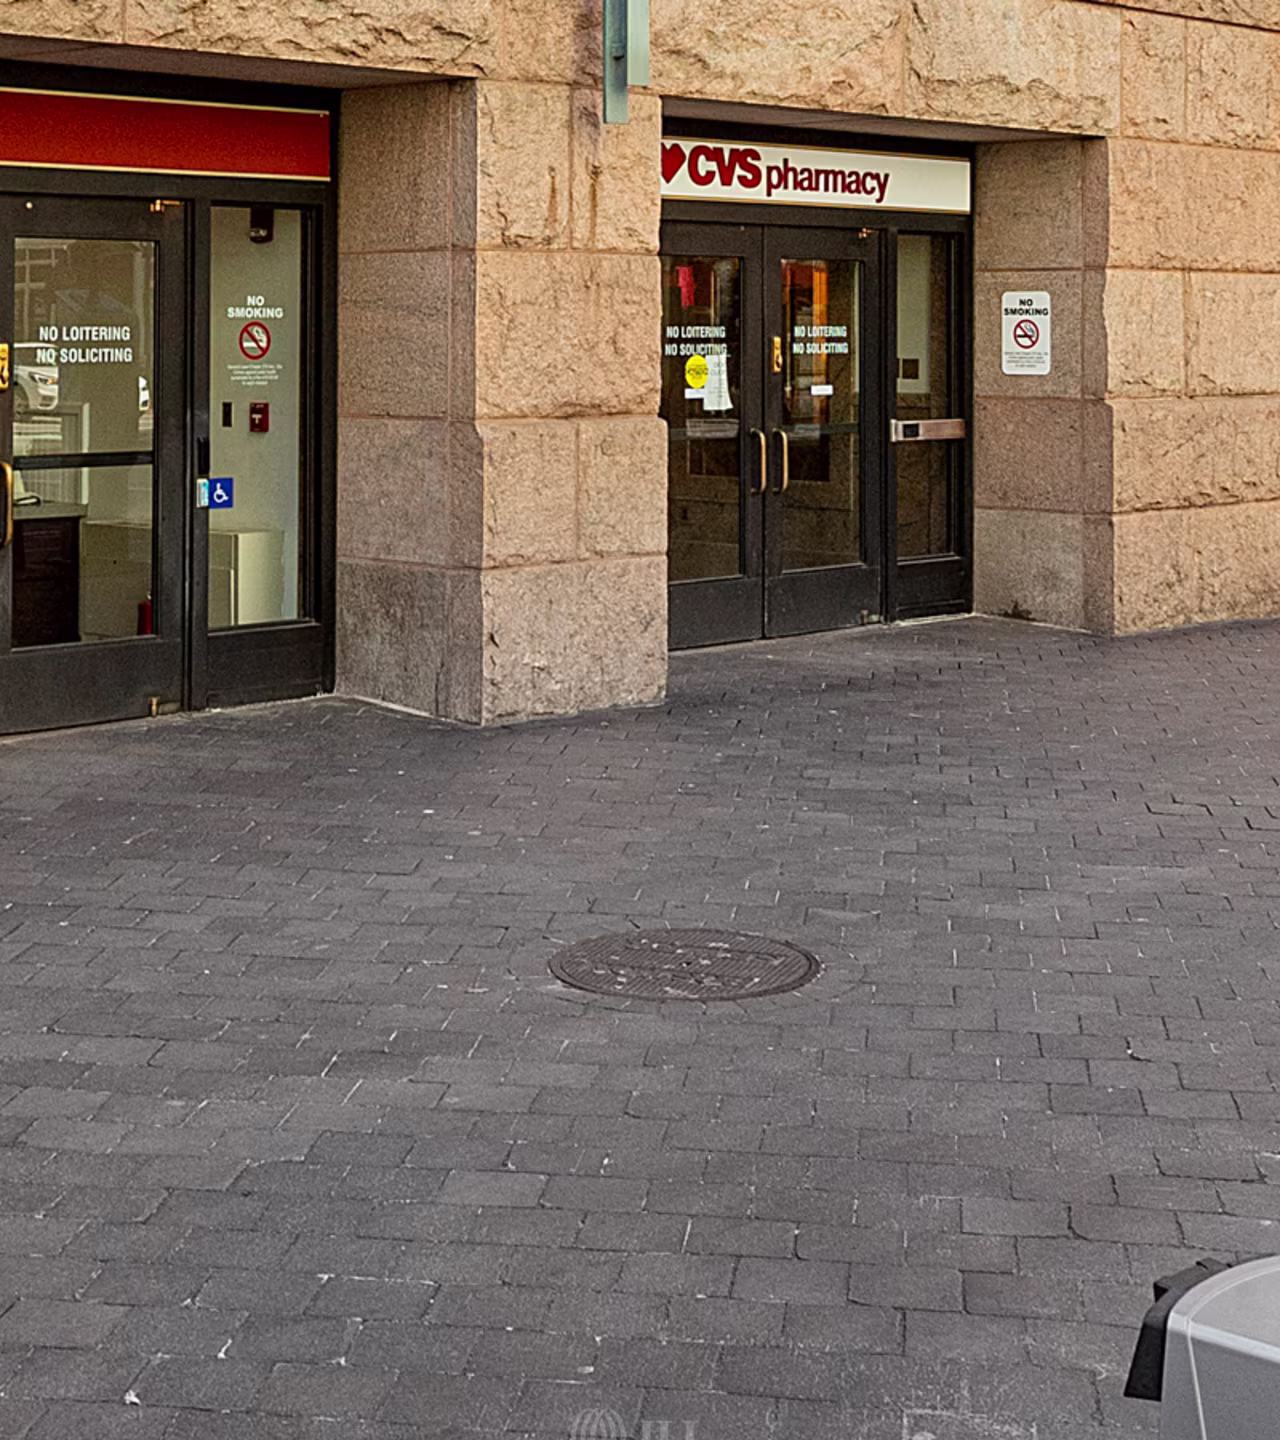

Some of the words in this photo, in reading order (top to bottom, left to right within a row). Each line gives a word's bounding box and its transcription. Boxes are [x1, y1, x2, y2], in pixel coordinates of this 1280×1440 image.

[687, 145, 762, 188] CVS
[766, 158, 890, 203] pharmacy
[247, 295, 265, 307] NO
[1019, 299, 1033, 307] NO
[227, 307, 284, 319] SMOKING
[1004, 308, 1049, 316] SMOKING
[39, 326, 58, 341] NO
[62, 326, 131, 341] LOITERING
[666, 325, 679, 338] NO
[681, 325, 726, 338] LOITERING
[794, 326, 805, 337] NO
[664, 343, 678, 356] NO
[680, 343, 727, 356] SOLICITING
[793, 342, 804, 354] NO
[36, 348, 56, 363] NO
[60, 348, 133, 363] SOLICITING
